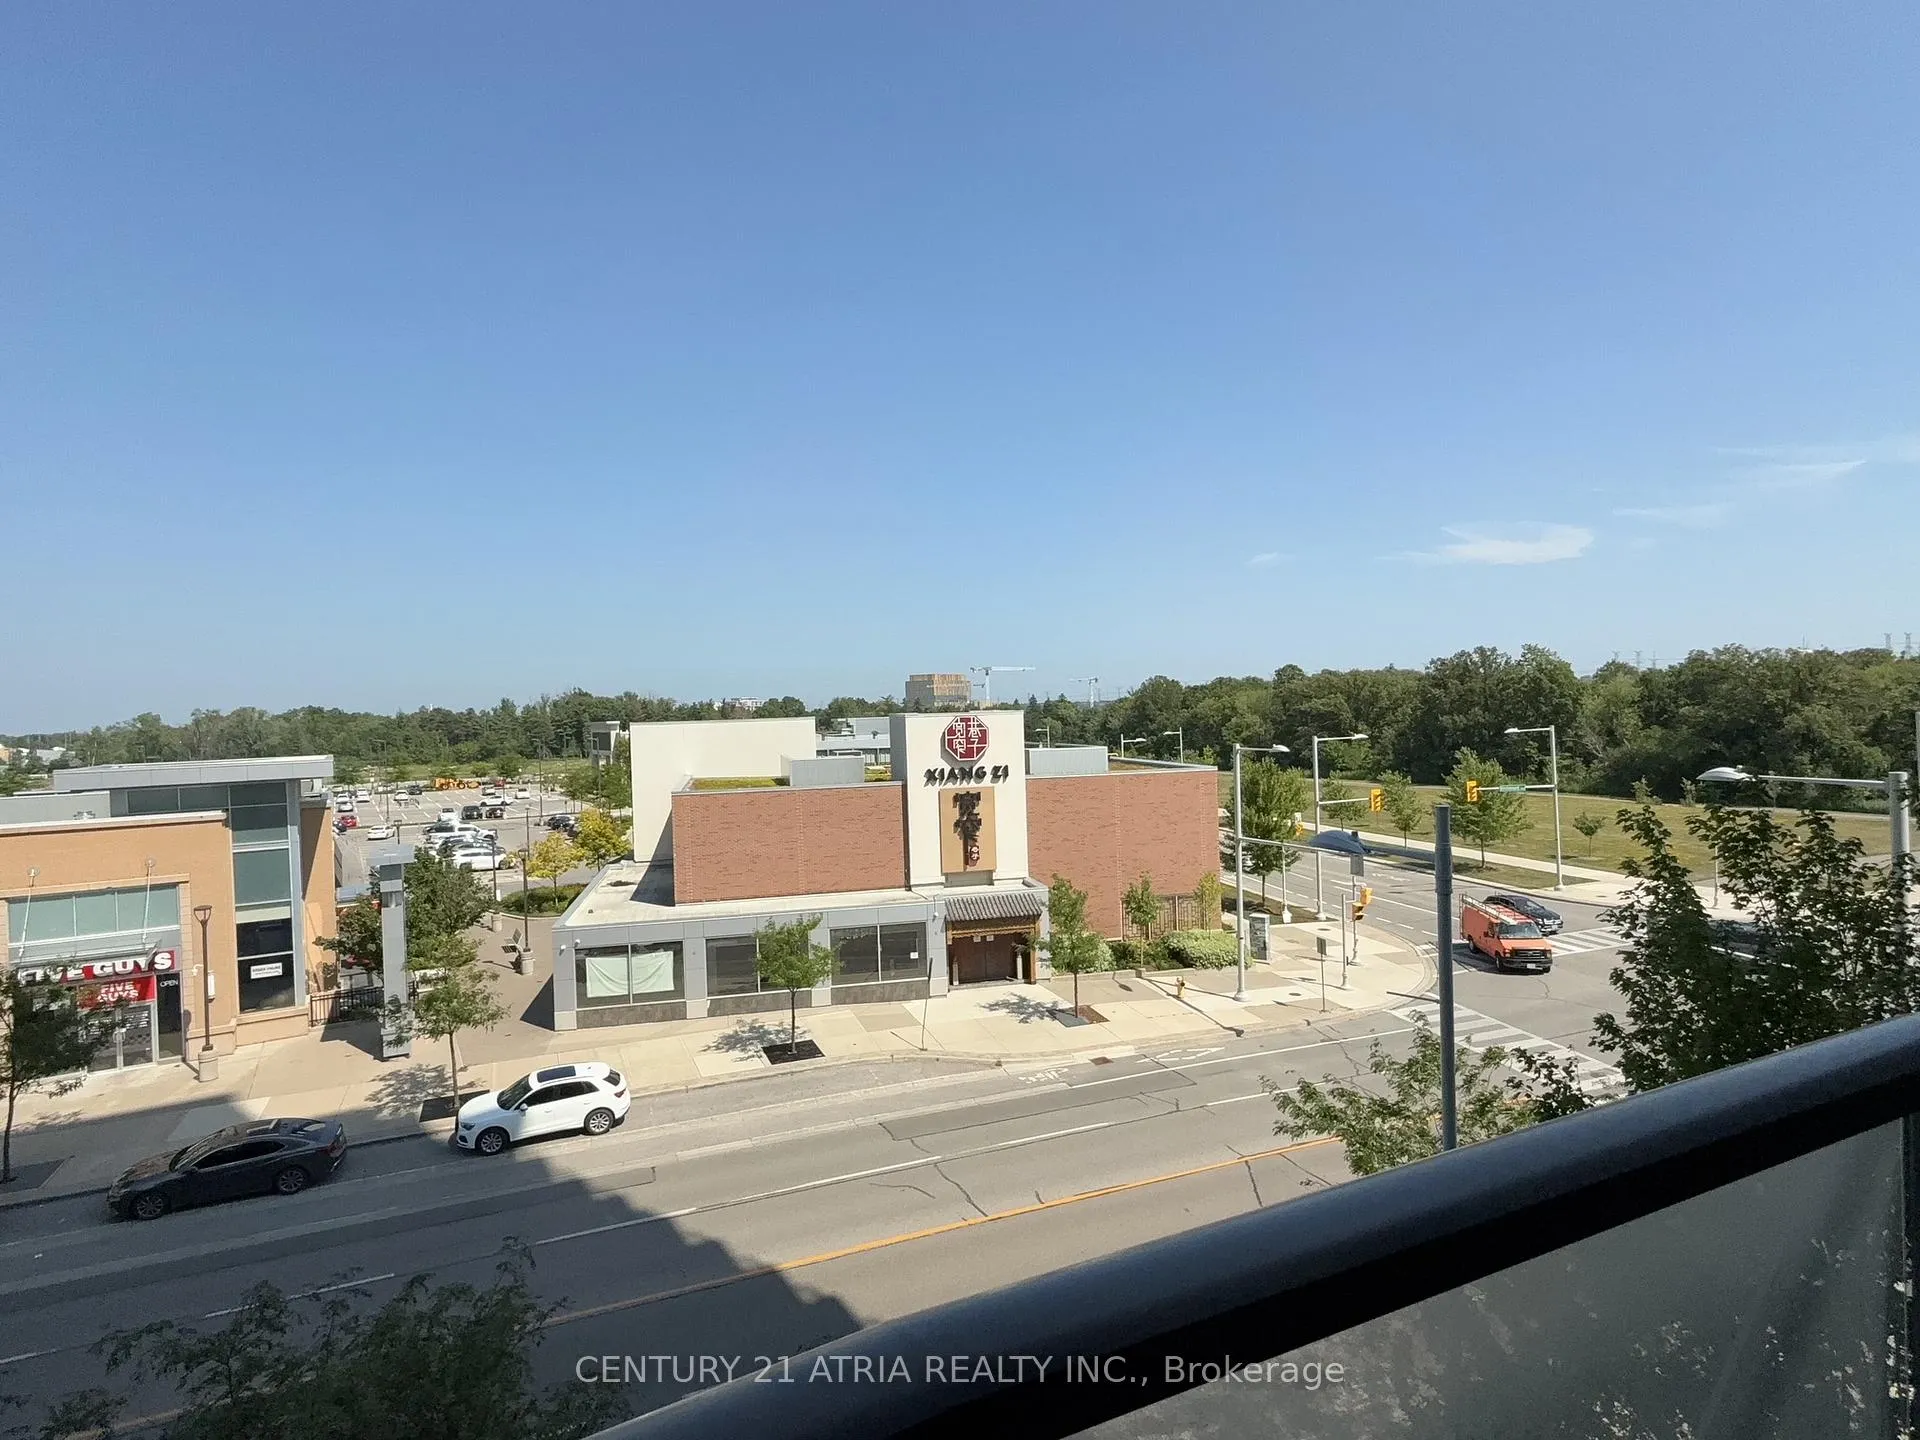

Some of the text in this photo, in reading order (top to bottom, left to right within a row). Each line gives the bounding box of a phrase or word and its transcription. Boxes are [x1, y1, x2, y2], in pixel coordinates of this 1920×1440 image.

[924, 765, 1009, 784] XIANG ZI
[93, 952, 172, 977] GUYS
[101, 981, 135, 992] FIVE
[160, 979, 179, 987] OPEN
